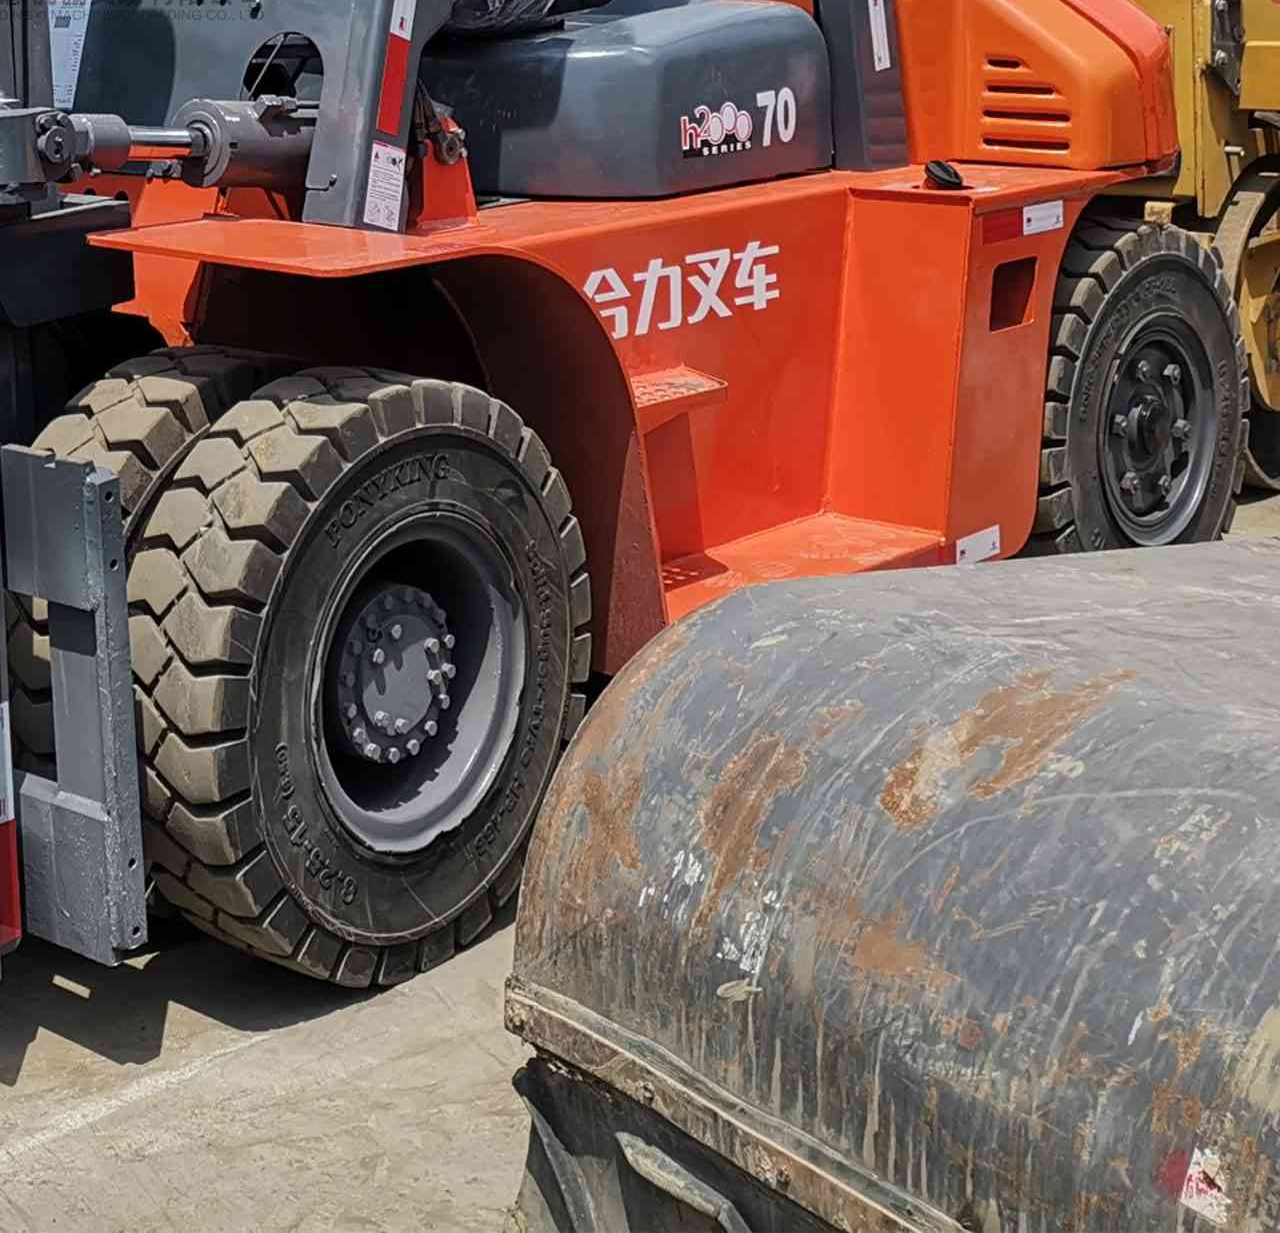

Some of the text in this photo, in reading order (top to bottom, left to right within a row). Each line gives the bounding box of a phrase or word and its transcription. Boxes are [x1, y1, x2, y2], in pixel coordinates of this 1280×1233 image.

[756, 86, 797, 147] 70
[702, 140, 752, 156] SERIES
[582, 240, 780, 340] 合力叉车
